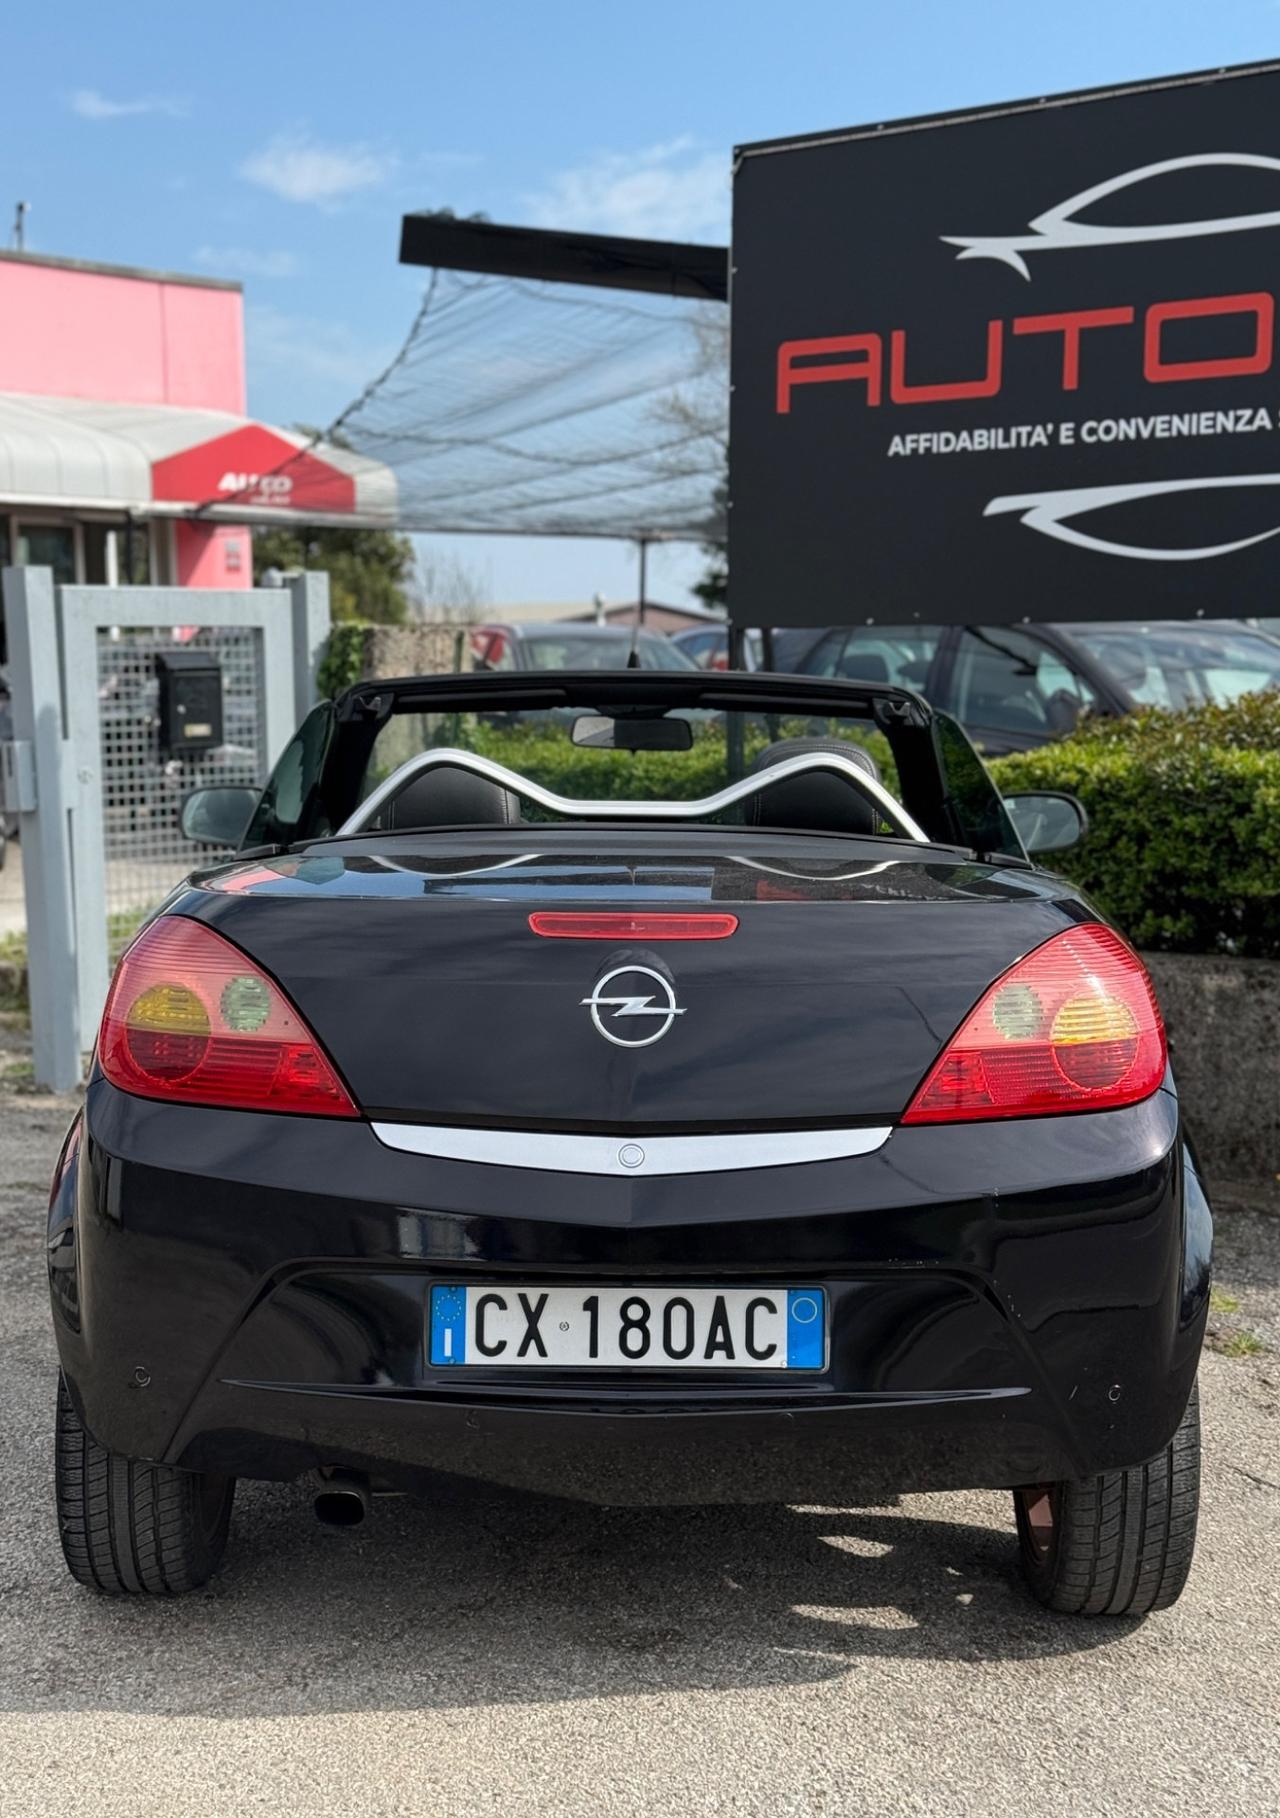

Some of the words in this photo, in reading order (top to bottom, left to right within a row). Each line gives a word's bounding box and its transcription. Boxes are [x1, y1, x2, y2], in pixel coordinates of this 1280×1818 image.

[777, 292, 1274, 414] AUTO
[887, 423, 1054, 457] AFFIDABILITA'
[1059, 422, 1075, 445] E
[1080, 407, 1273, 443] CONVENIENZA
[475, 1292, 550, 1358] CX
[582, 1295, 778, 1361] 180AC
